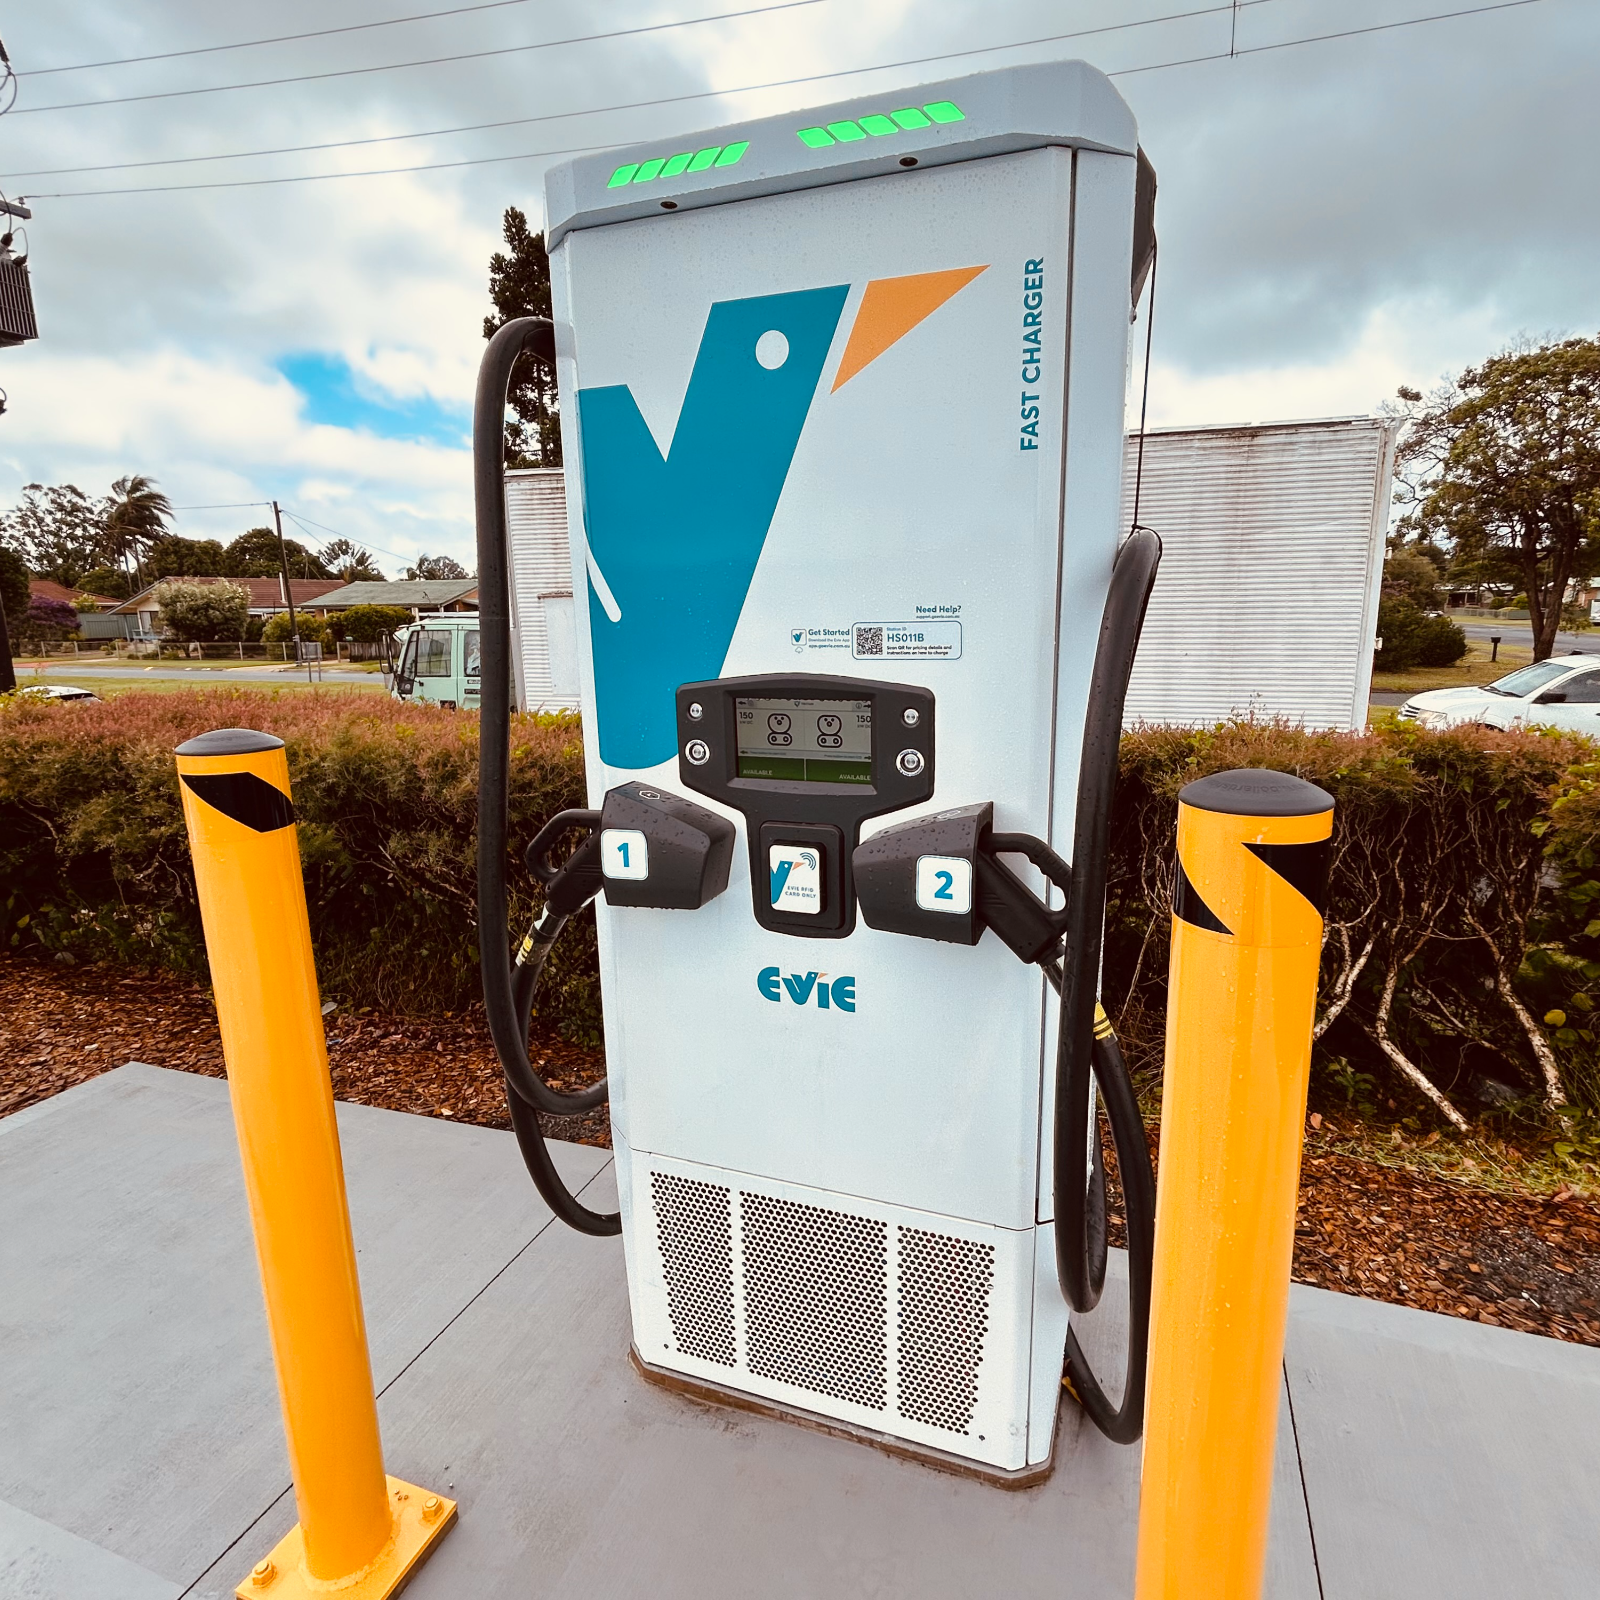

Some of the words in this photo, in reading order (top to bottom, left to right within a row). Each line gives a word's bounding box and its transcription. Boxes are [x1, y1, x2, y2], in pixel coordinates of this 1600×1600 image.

[1021, 257, 1044, 383] CHARGER
[1019, 391, 1040, 451] FAST
[915, 605, 937, 613] Need
[938, 605, 961, 614] Help?
[808, 628, 821, 636] Get
[822, 628, 850, 636] Started
[887, 633, 925, 642] HS011B
[739, 711, 754, 720] 150
[856, 714, 871, 723] 150
[616, 842, 630, 868] 1
[933, 870, 954, 900] 2
